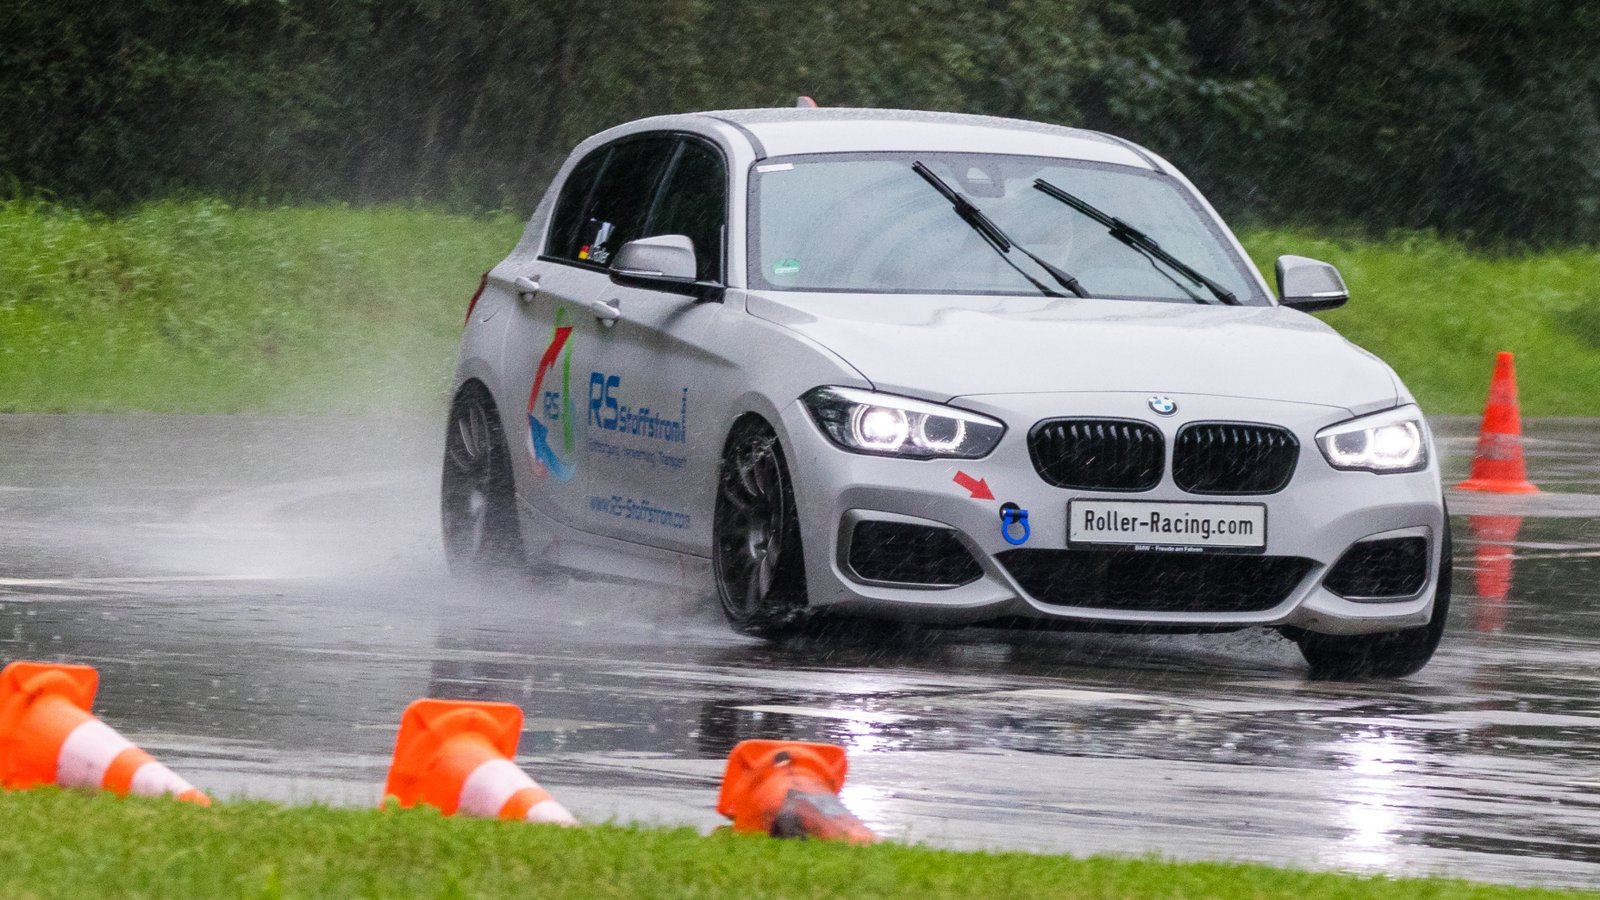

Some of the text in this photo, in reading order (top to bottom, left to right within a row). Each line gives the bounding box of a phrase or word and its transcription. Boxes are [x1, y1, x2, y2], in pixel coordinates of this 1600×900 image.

[544, 391, 560, 420] RS
[589, 372, 620, 430] RS
[1085, 510, 1254, 539] Roller-Racing.com
